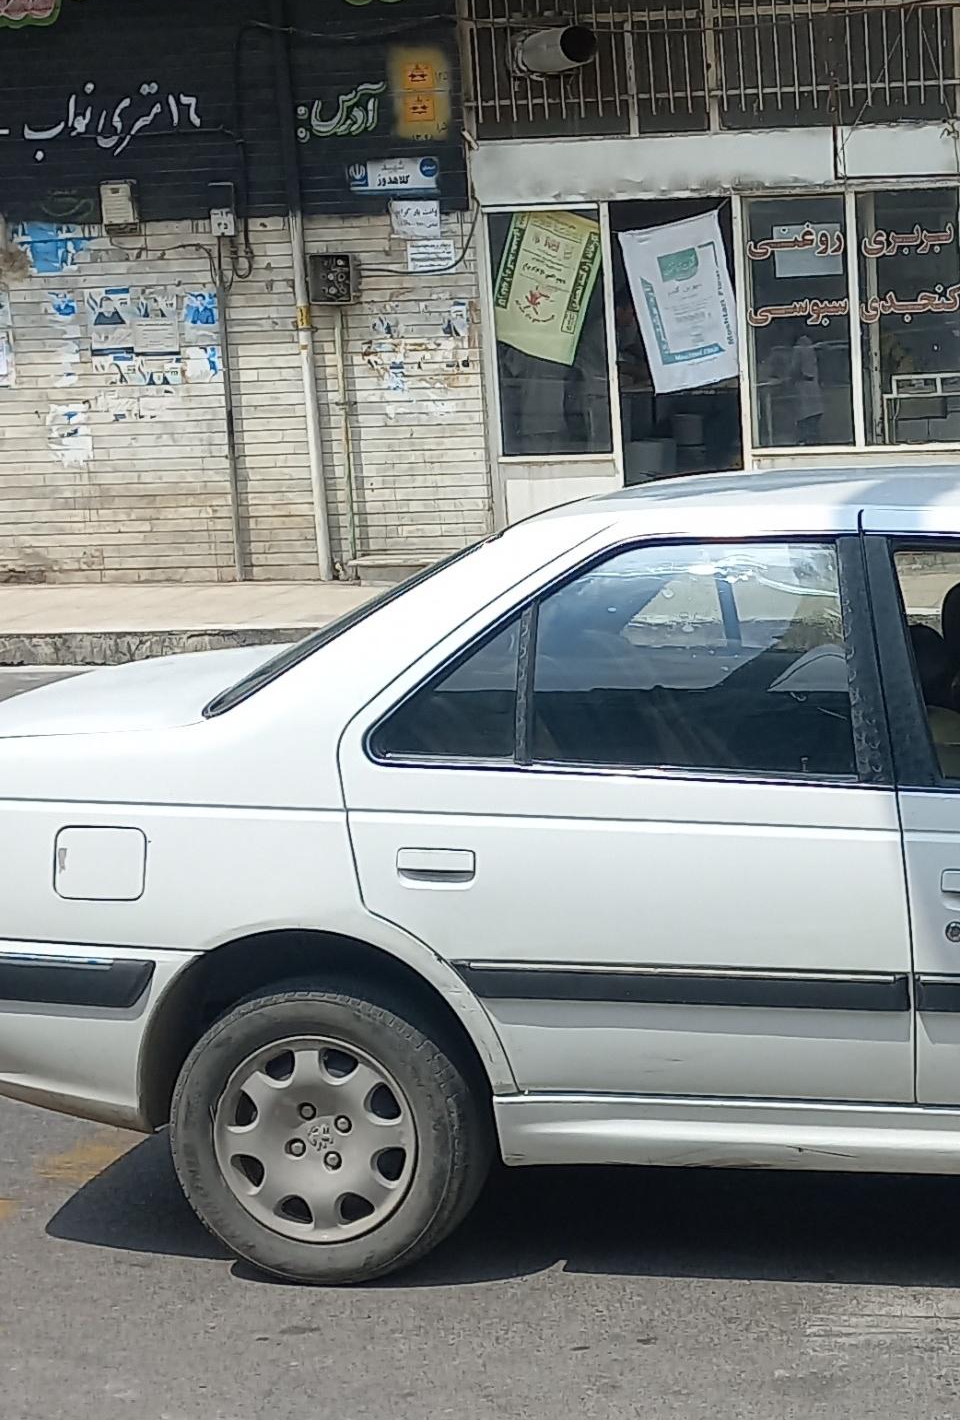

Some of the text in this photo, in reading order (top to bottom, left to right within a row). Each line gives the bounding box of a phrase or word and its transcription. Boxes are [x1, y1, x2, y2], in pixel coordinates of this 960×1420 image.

[24, 82, 95, 161] نواب
[96, 82, 162, 157] متری
[747, 222, 955, 260] بربری روغنی
[747, 296, 849, 326] سبوسی
